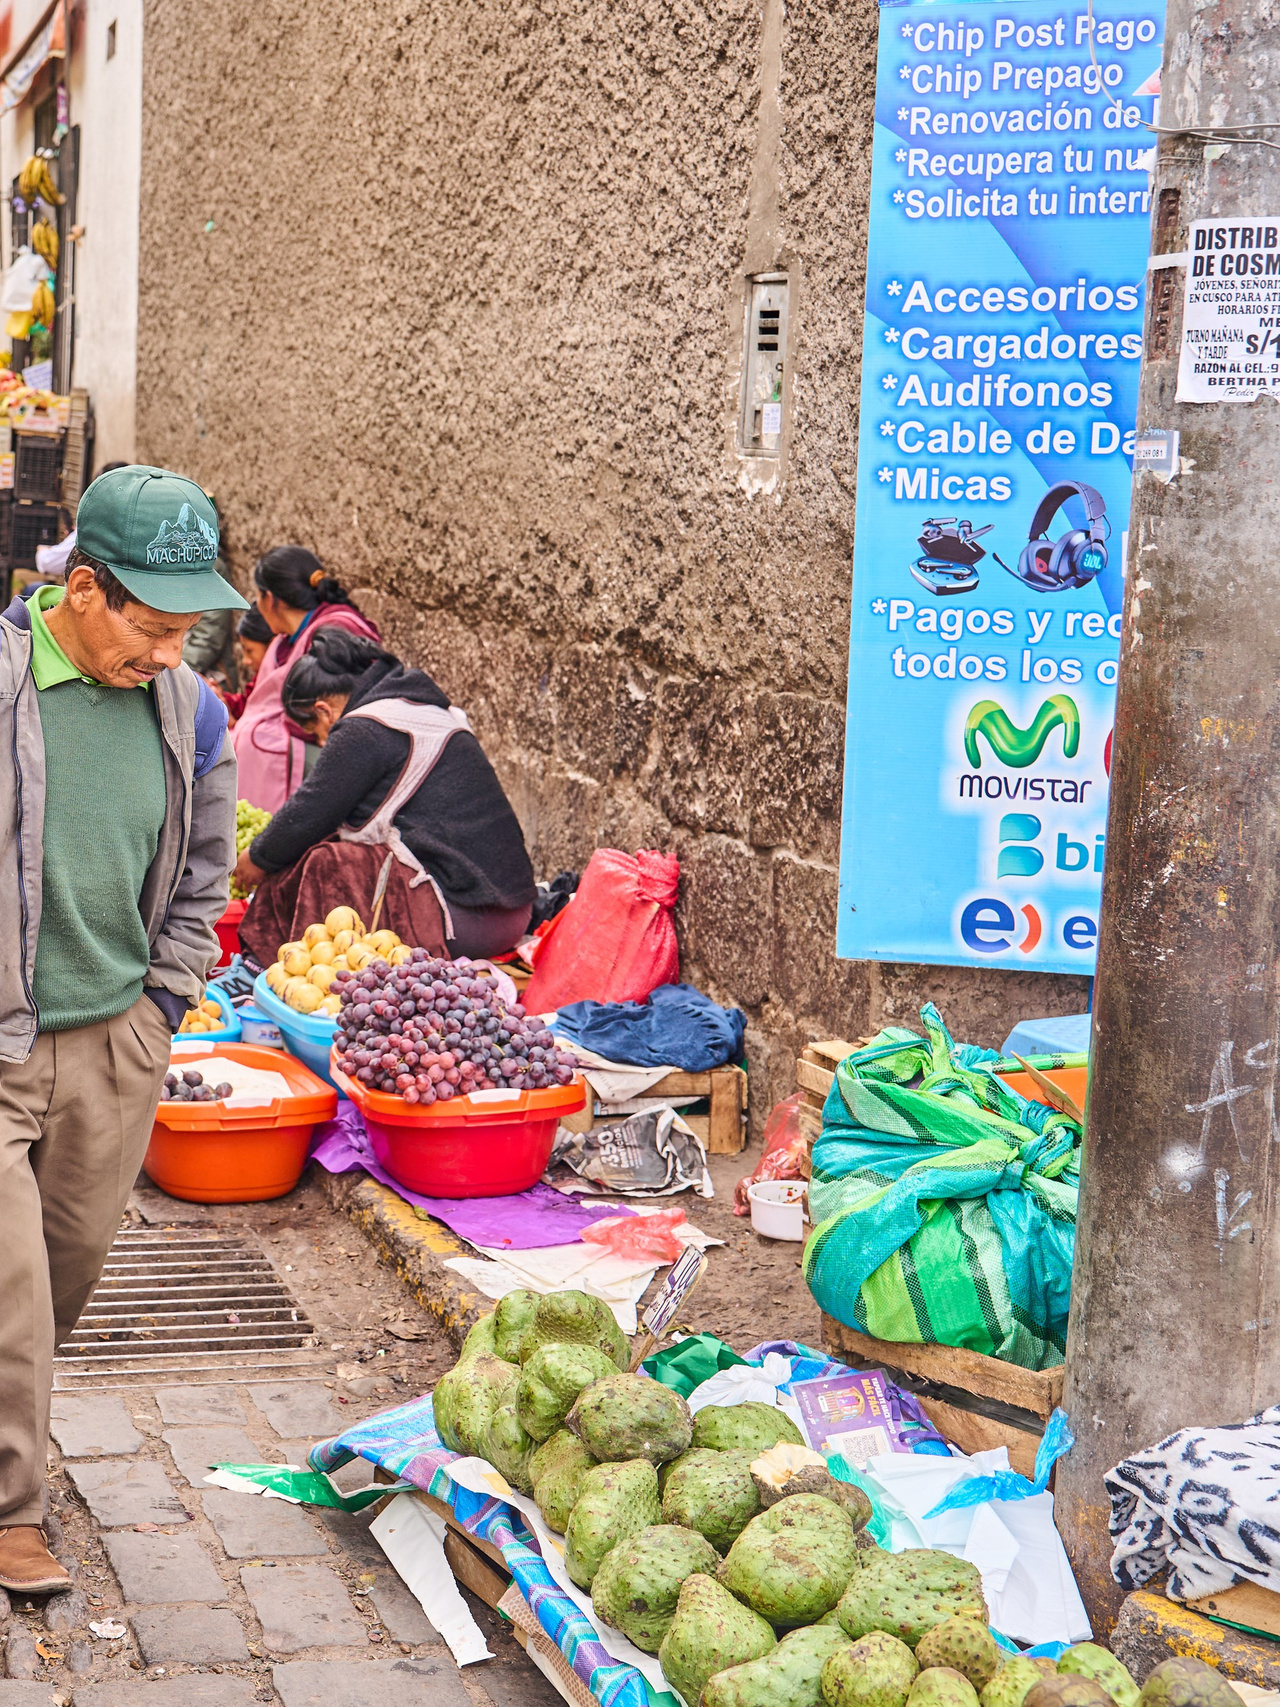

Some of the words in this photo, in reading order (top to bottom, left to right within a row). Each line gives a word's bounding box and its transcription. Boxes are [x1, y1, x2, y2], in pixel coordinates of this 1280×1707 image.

[994, 18, 1066, 49] Post
[1075, 15, 1156, 50] Pago
[993, 61, 1123, 96] Prepago
[1103, 99, 1141, 129] de
[1063, 145, 1093, 172] tu
[1104, 148, 1153, 171] nu
[1028, 187, 1058, 215] tu
[1192, 254, 1215, 277] DE
[1194, 277, 1238, 291] JÓVENES,
[1240, 276, 1280, 290] SEÑORI
[1189, 293, 1200, 304] EN
[1202, 292, 1233, 303] CUSCO
[1235, 292, 1261, 302] PARA
[1263, 292, 1280, 302] AT
[1217, 304, 1269, 315] HORARIOS
[1186, 329, 1210, 343] TURNO
[1210, 325, 1244, 343] MAÑANA
[1204, 345, 1228, 359] TARDE
[1229, 363, 1241, 374] AL
[1207, 377, 1268, 386] BERTHA
[1026, 421, 1077, 455] de
[1083, 553, 1102, 570] JBL
[1028, 611, 1051, 643] y
[893, 647, 1007, 681] todos
[1022, 650, 1082, 684] los
